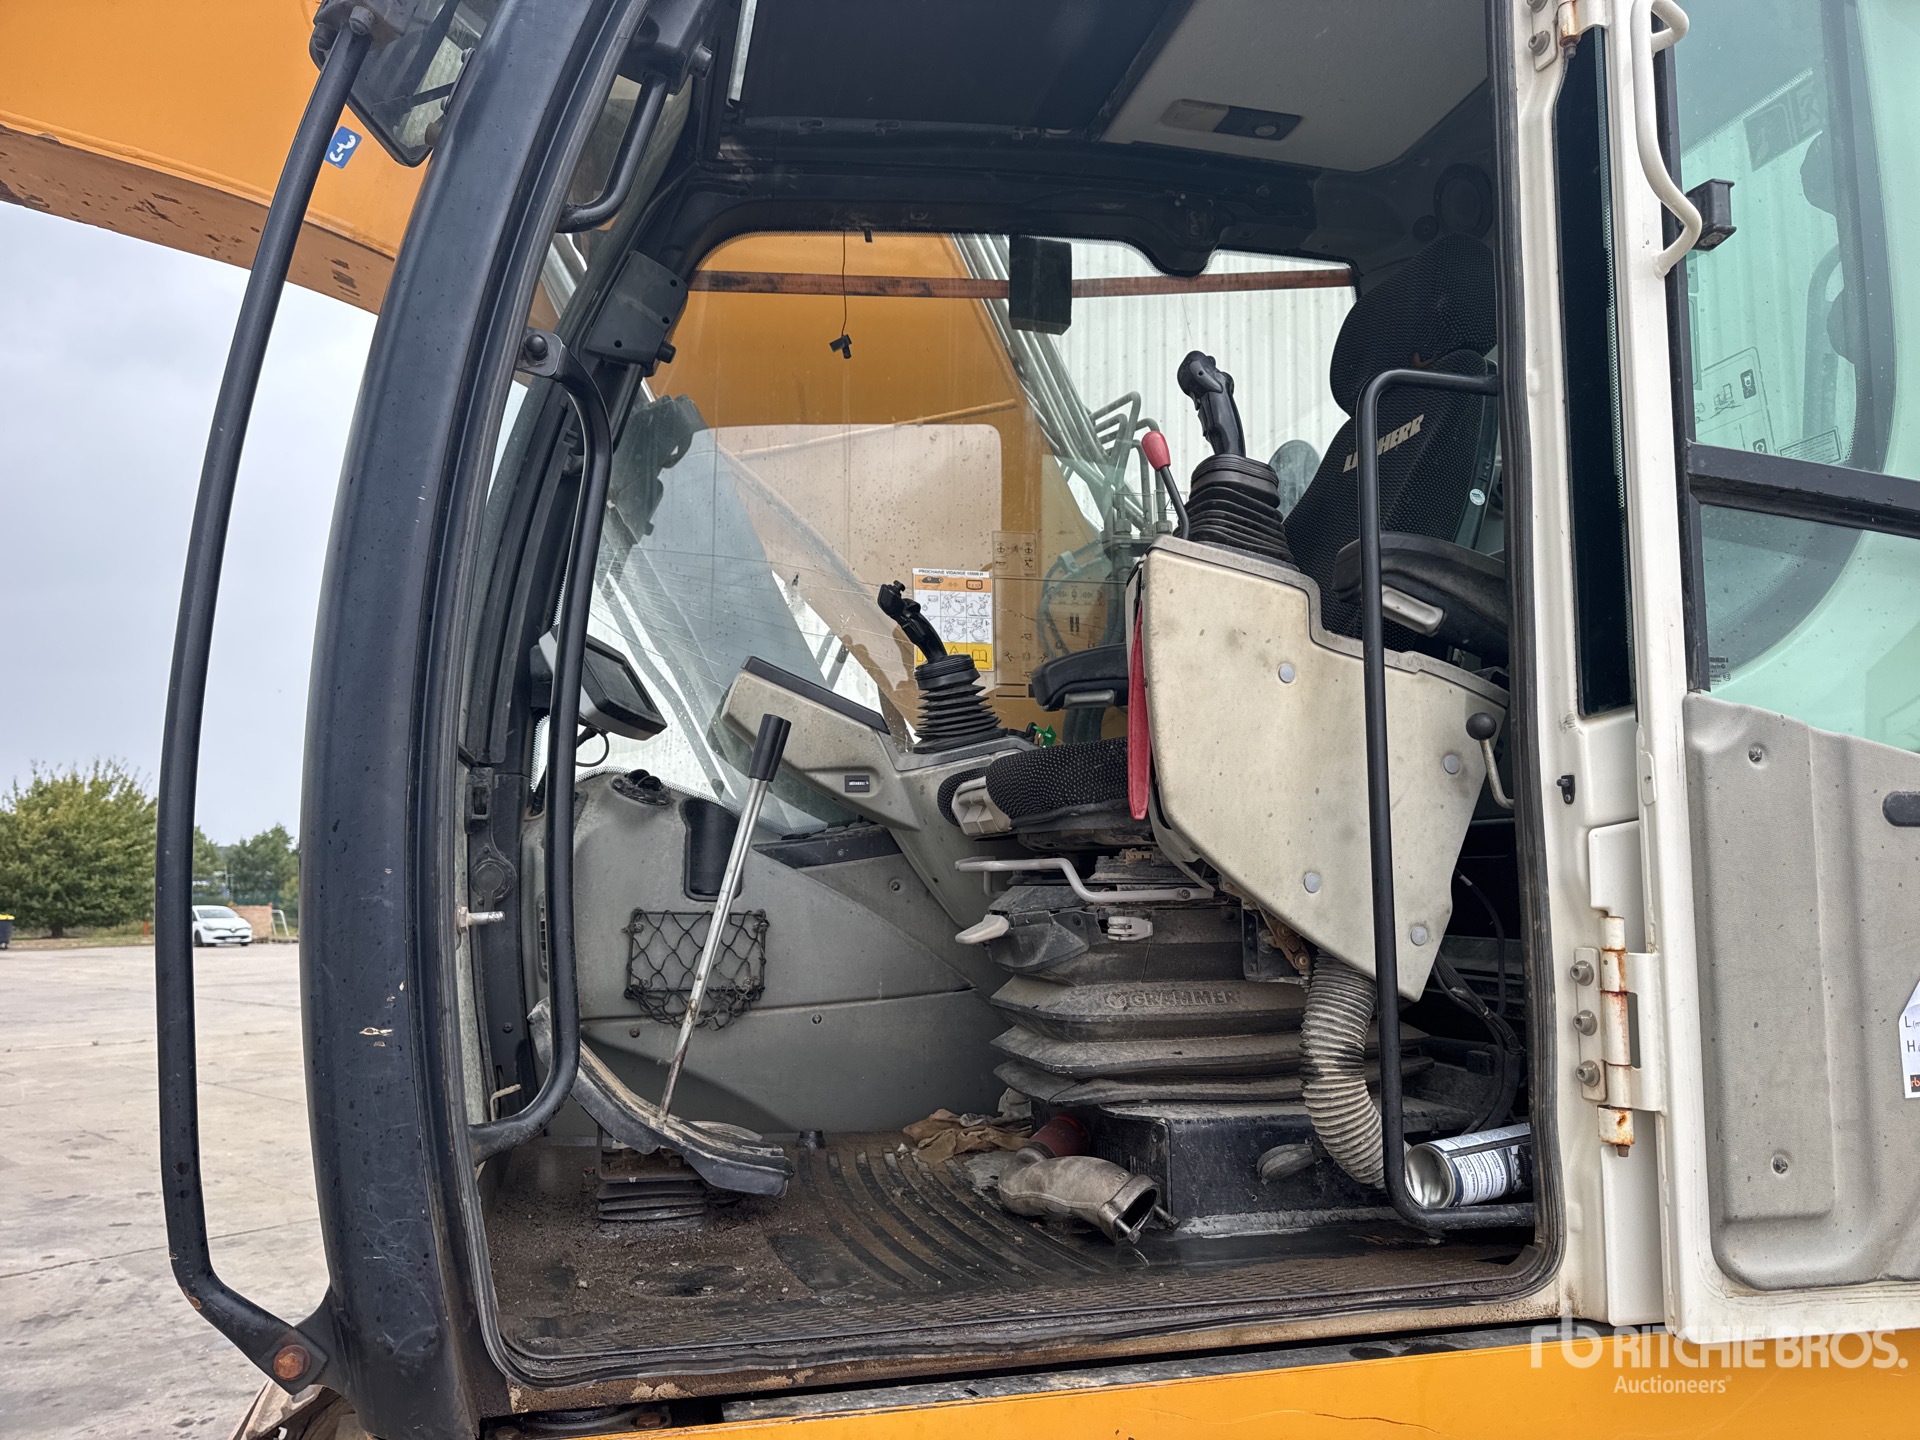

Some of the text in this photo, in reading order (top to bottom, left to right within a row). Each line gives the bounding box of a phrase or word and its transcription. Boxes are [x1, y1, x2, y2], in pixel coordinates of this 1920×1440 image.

[1343, 414, 1424, 473] LIHERR
[1130, 990, 1238, 1007] GRAMMER
[1462, 1157, 1473, 1173] Brake
